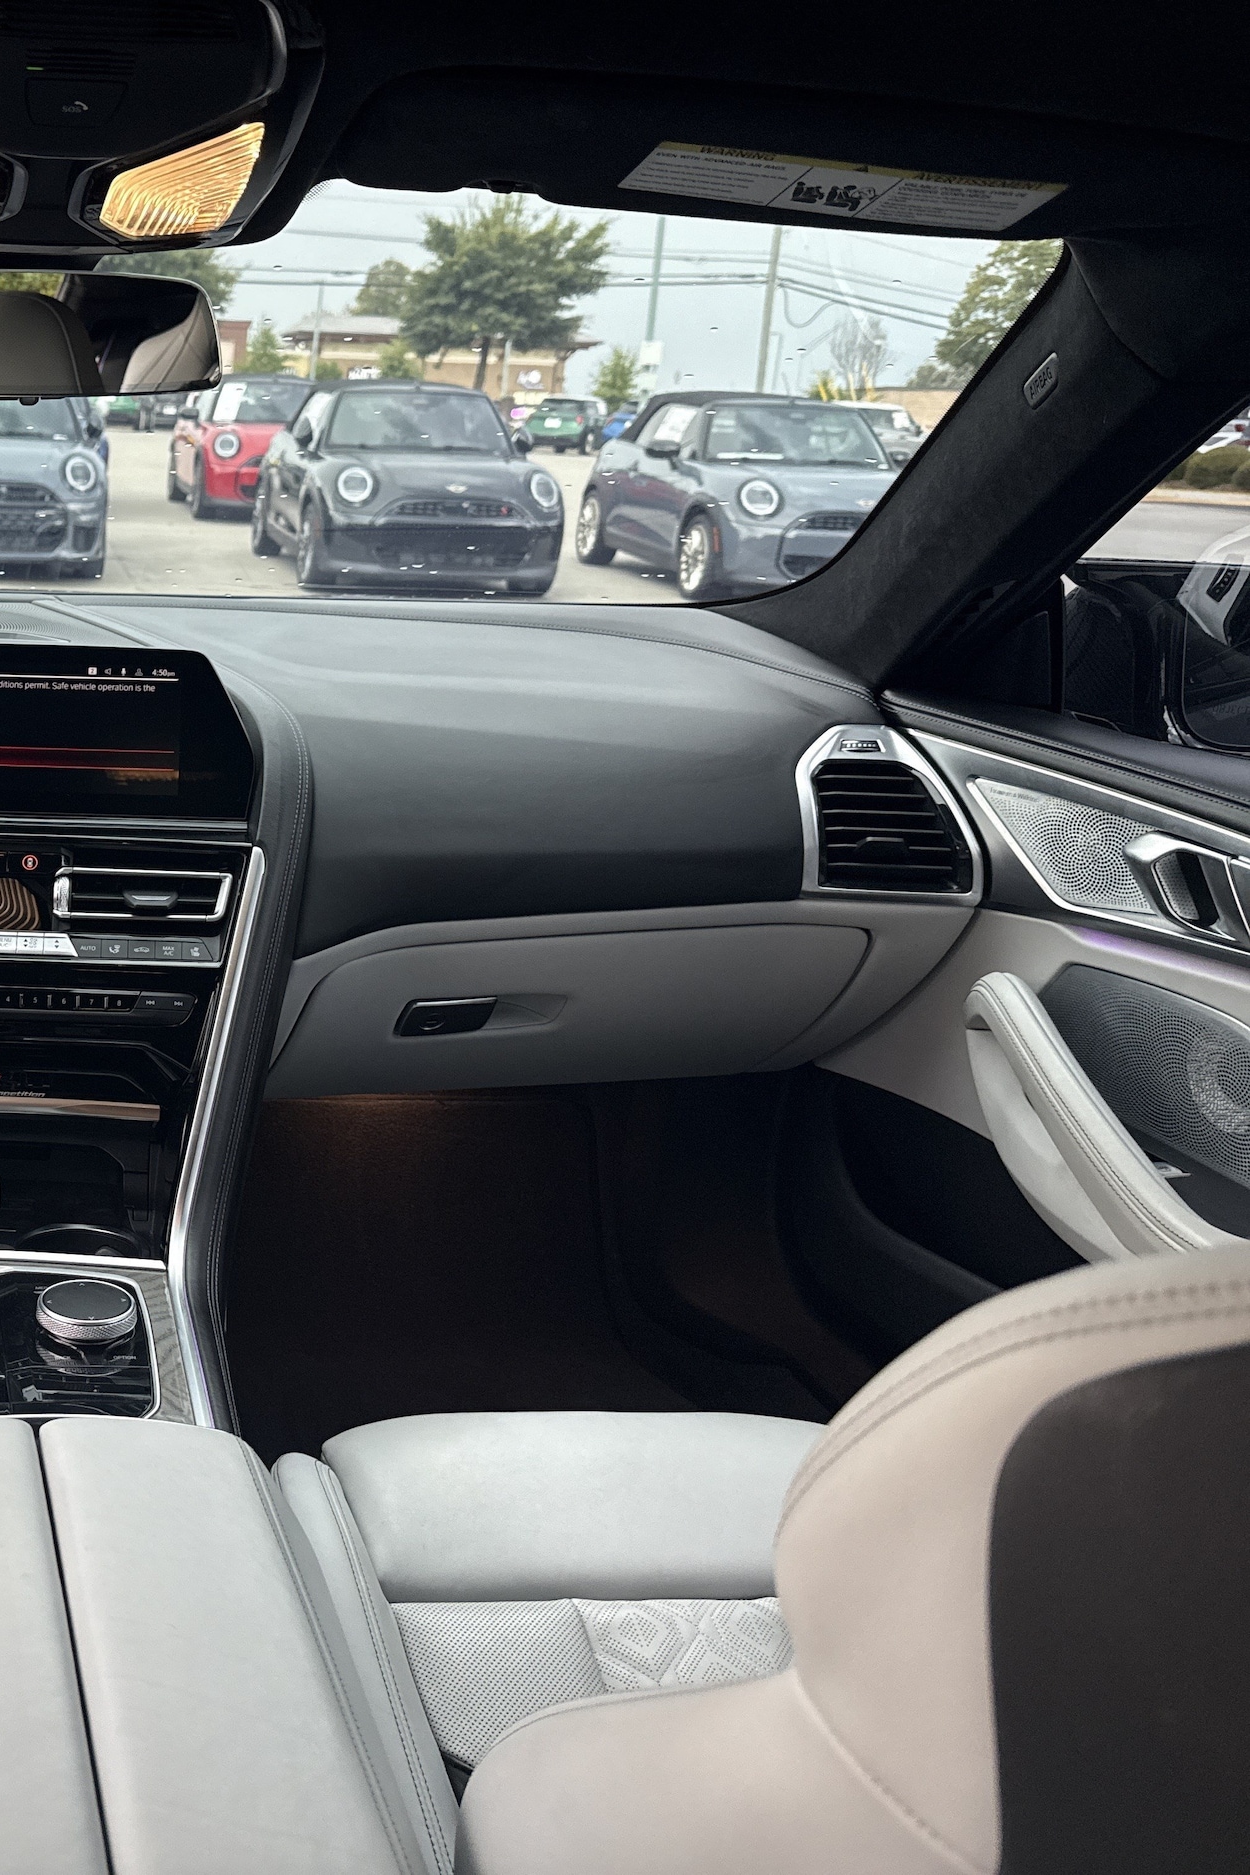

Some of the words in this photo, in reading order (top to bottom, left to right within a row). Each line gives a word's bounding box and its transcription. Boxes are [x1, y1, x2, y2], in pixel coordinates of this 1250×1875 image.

[700, 146, 776, 162] WARNING
[24, 681, 51, 690] permit.
[52, 682, 69, 690] Safe
[70, 682, 96, 691] vehicle
[97, 683, 134, 692] operation
[143, 684, 156, 692] the
[32, 996, 38, 1004] 5
[61, 997, 67, 1005] 6
[116, 999, 122, 1007] 8
